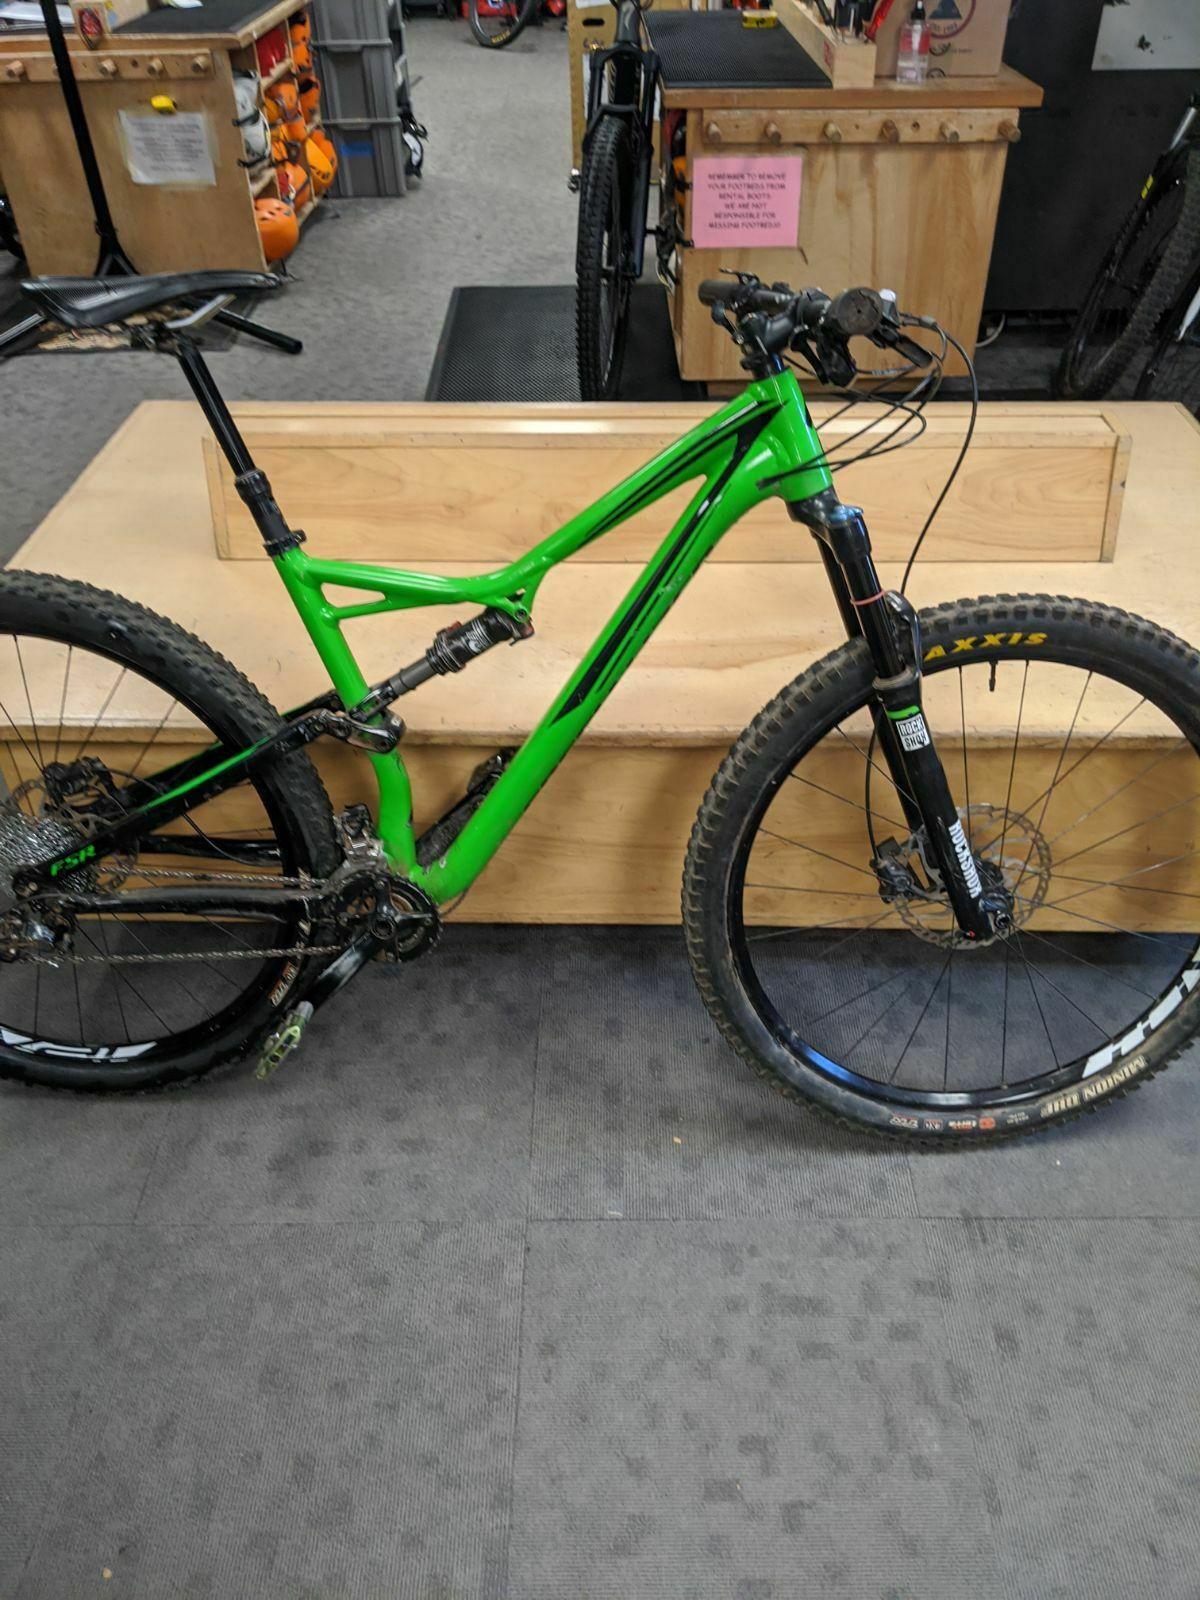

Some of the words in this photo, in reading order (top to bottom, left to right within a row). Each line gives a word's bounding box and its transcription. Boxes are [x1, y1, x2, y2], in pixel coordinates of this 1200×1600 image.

[924, 632, 1048, 662] AXXIS
[899, 717, 925, 737] ROCK
[50, 844, 97, 877] FSR
[948, 820, 983, 899] ROCKSHOX
[1083, 1055, 1147, 1102] MINION
